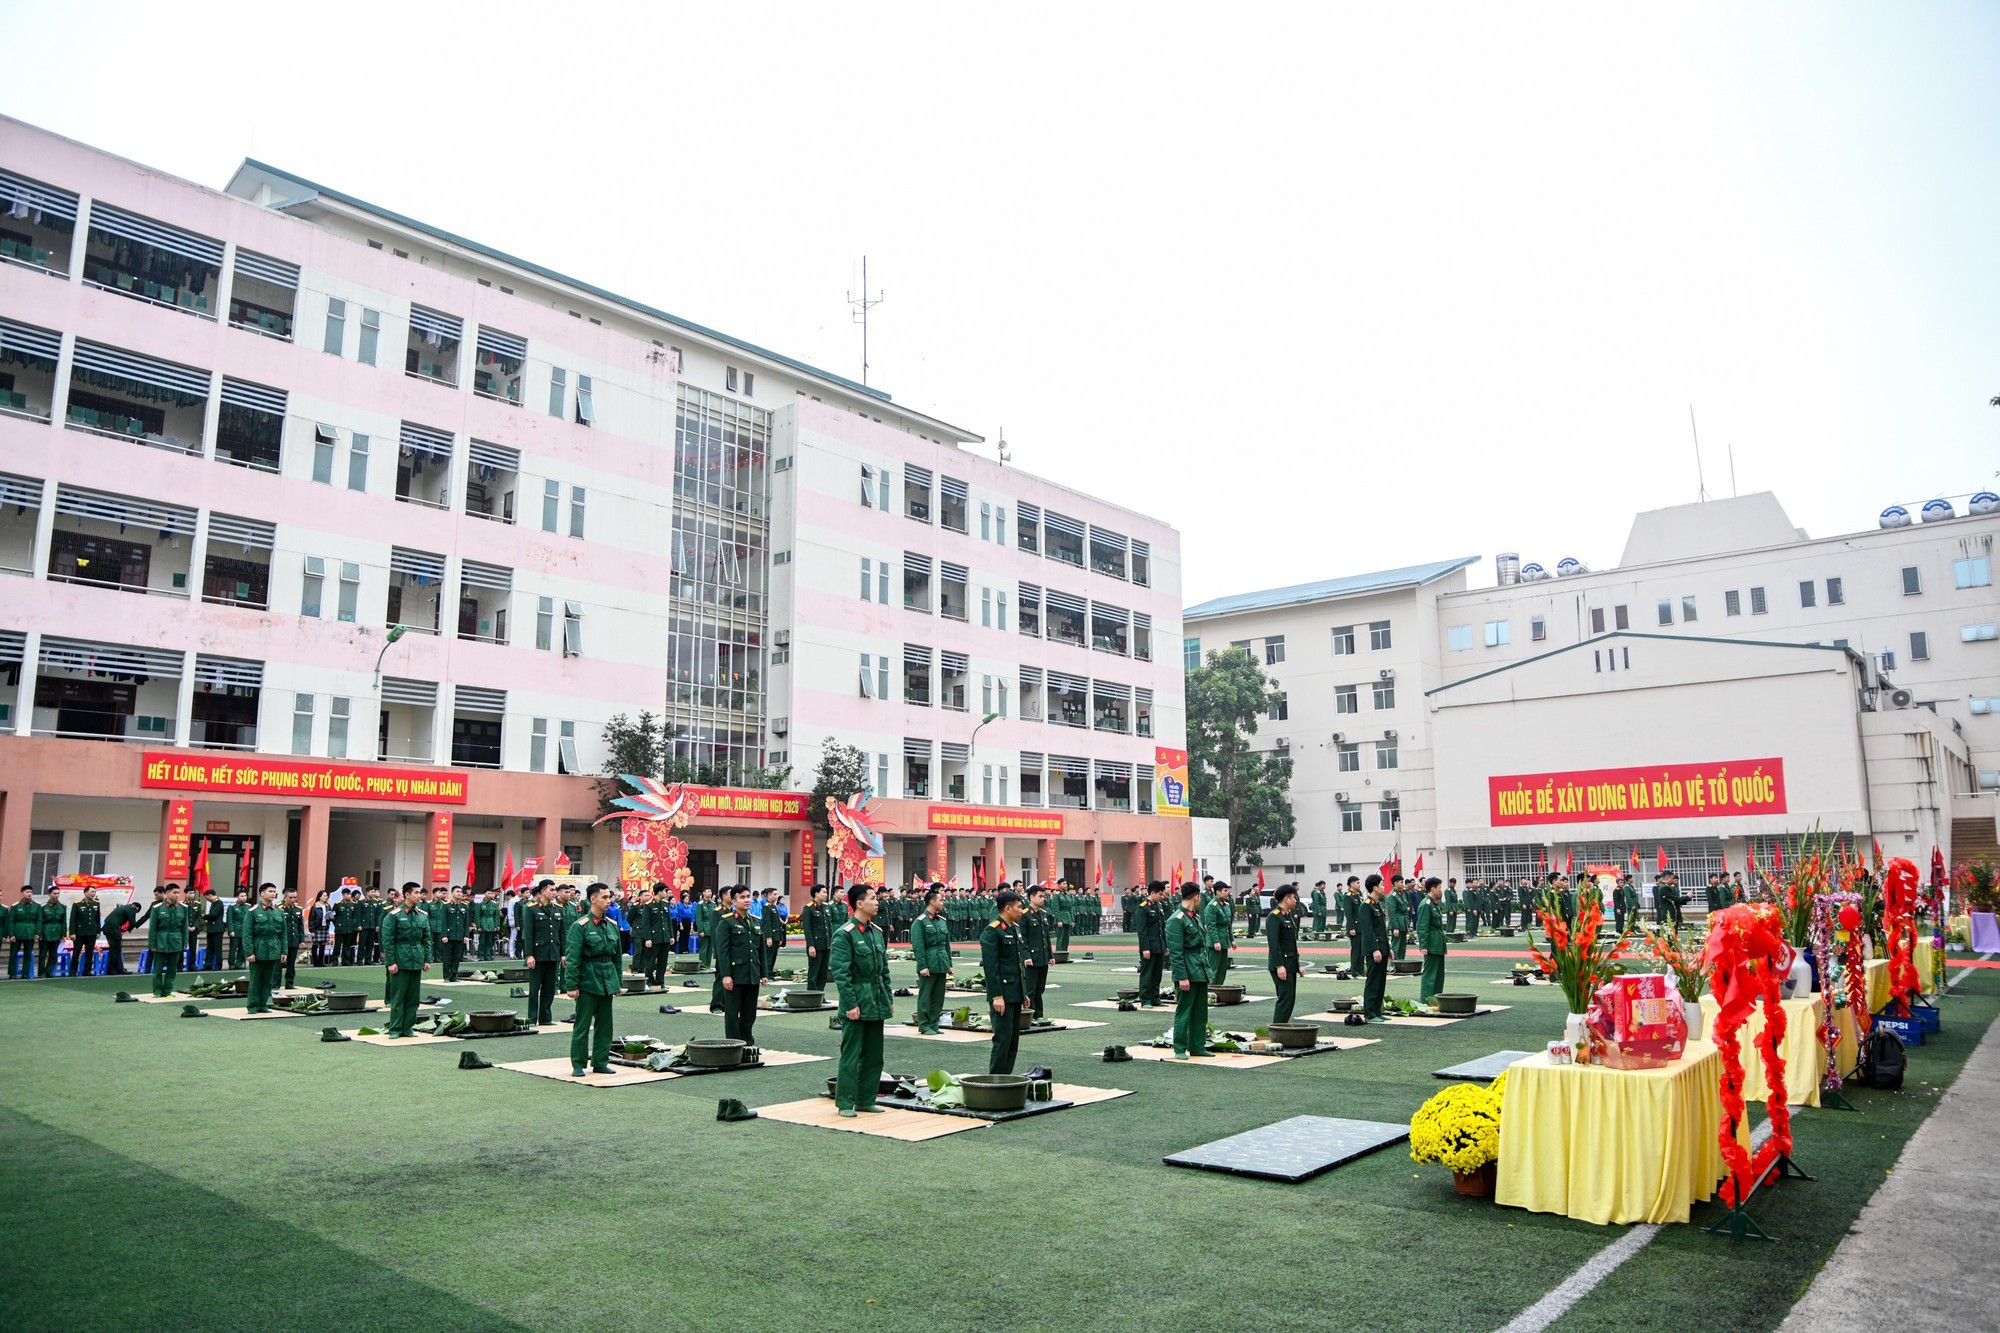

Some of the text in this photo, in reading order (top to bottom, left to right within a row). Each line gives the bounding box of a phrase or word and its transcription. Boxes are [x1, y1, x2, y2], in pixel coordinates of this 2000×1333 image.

[147, 759, 462, 796] HẾT LÒNG, HẾT SỨC PHỤNG SỰ TỔ QUỐC, PHỤC VỤ NHÂN DÂN!
[1498, 766, 1775, 816] KHỎE ĐỂ XÂY DỰNG VÀ BẢO VỆ TỔ QUỐC
[700, 792, 799, 815] NĂM MỚI, XUÂN BÍNH NGỌ 2026
[626, 881, 638, 891] 20
[1878, 1020, 1909, 1030] PEPSI
